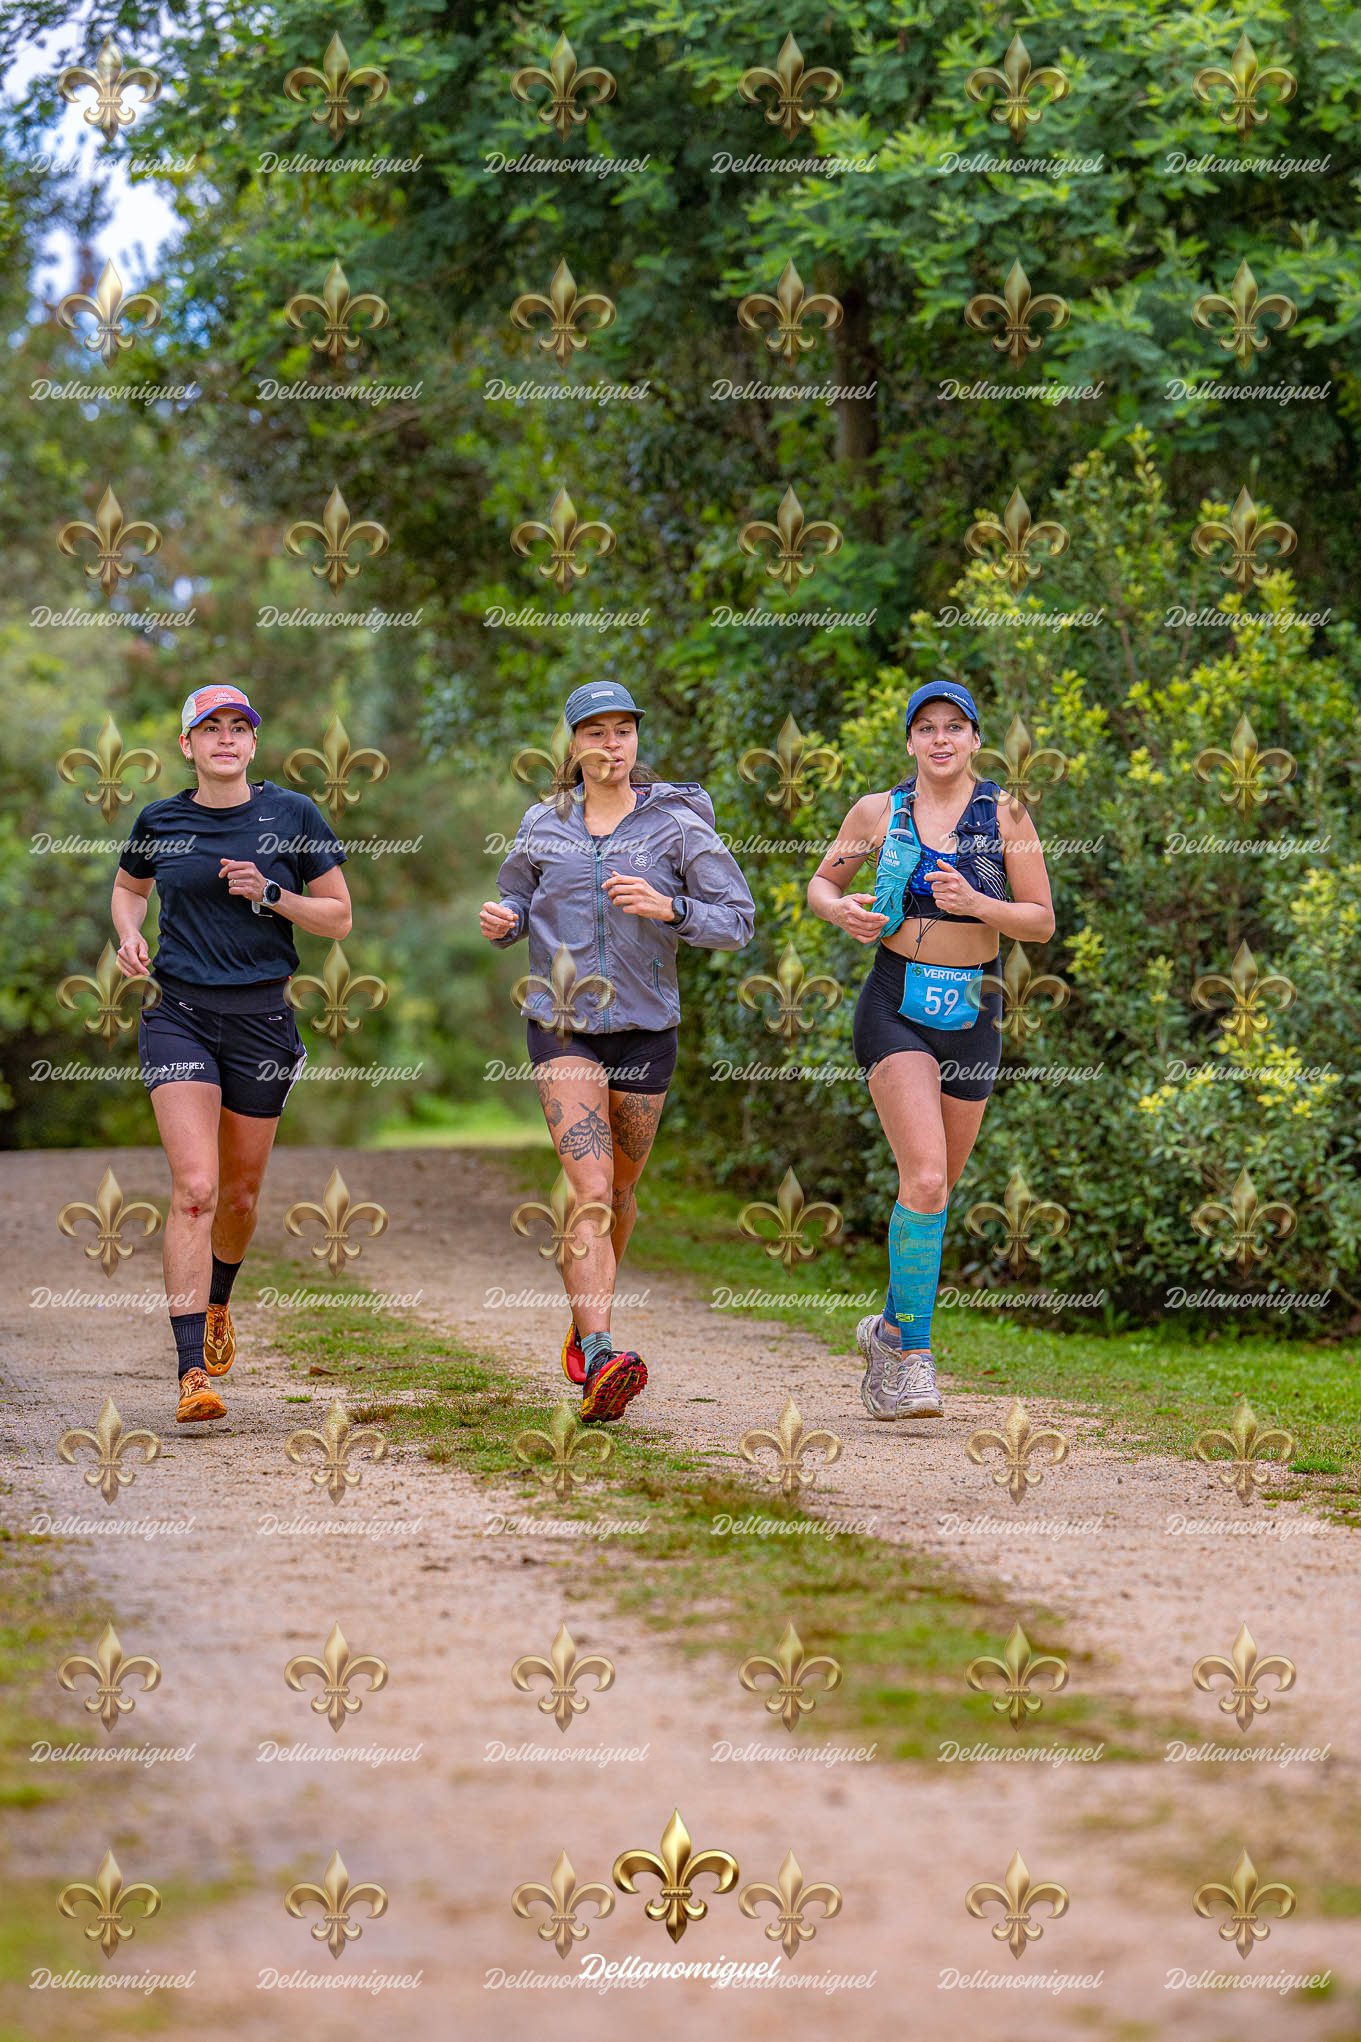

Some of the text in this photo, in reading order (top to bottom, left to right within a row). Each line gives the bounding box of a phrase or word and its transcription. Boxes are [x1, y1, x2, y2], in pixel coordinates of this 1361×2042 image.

[923, 967, 973, 982] VERTICAL
[924, 986, 959, 1017] 59
[169, 1062, 205, 1071] TERREX
